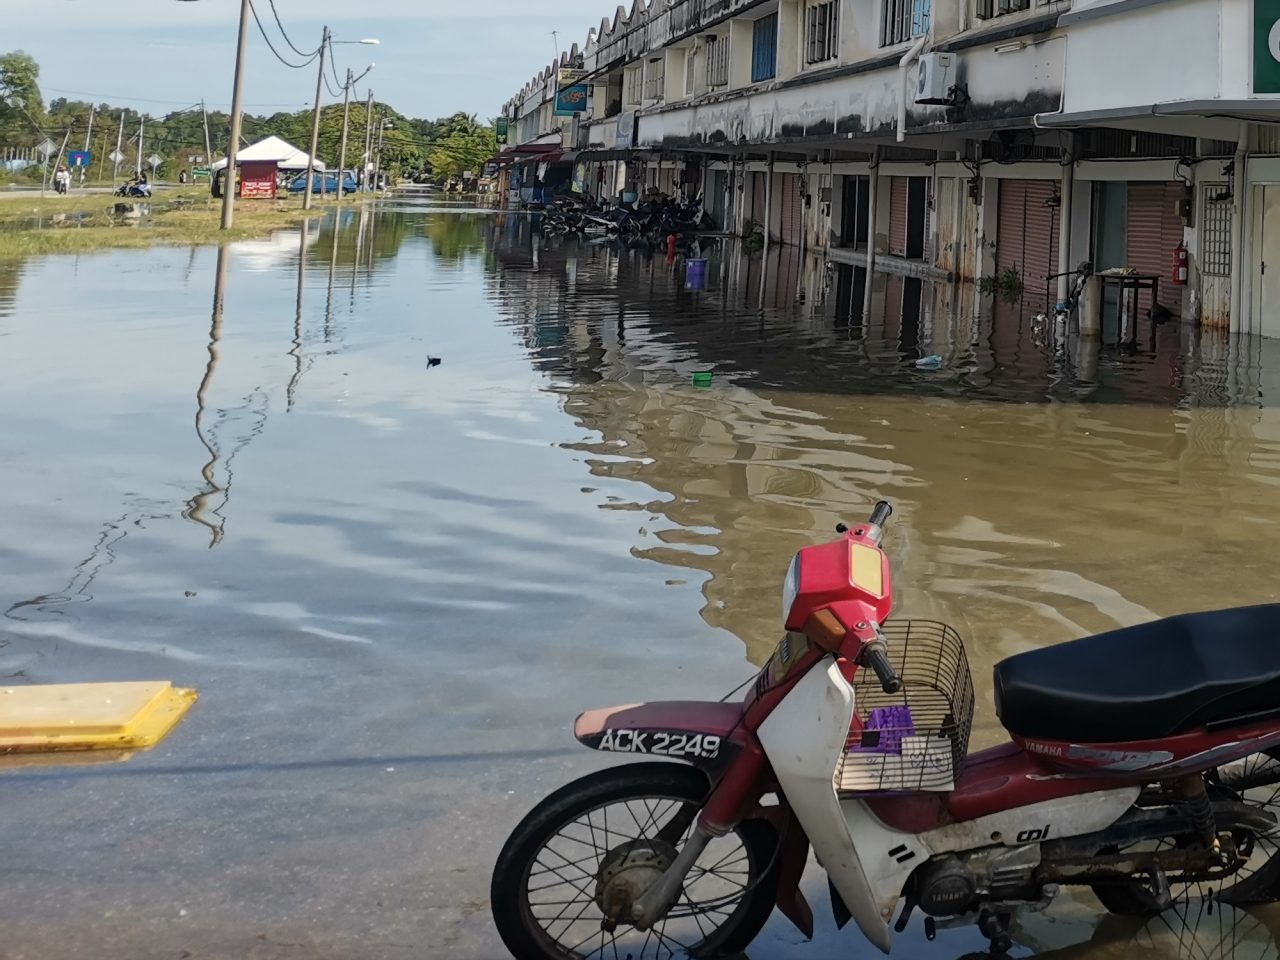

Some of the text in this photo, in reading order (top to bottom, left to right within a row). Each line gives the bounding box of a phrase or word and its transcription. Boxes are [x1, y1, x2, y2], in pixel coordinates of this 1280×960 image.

[598, 728, 721, 759] ACK 2249
[1025, 739, 1062, 757] YAMAHA
